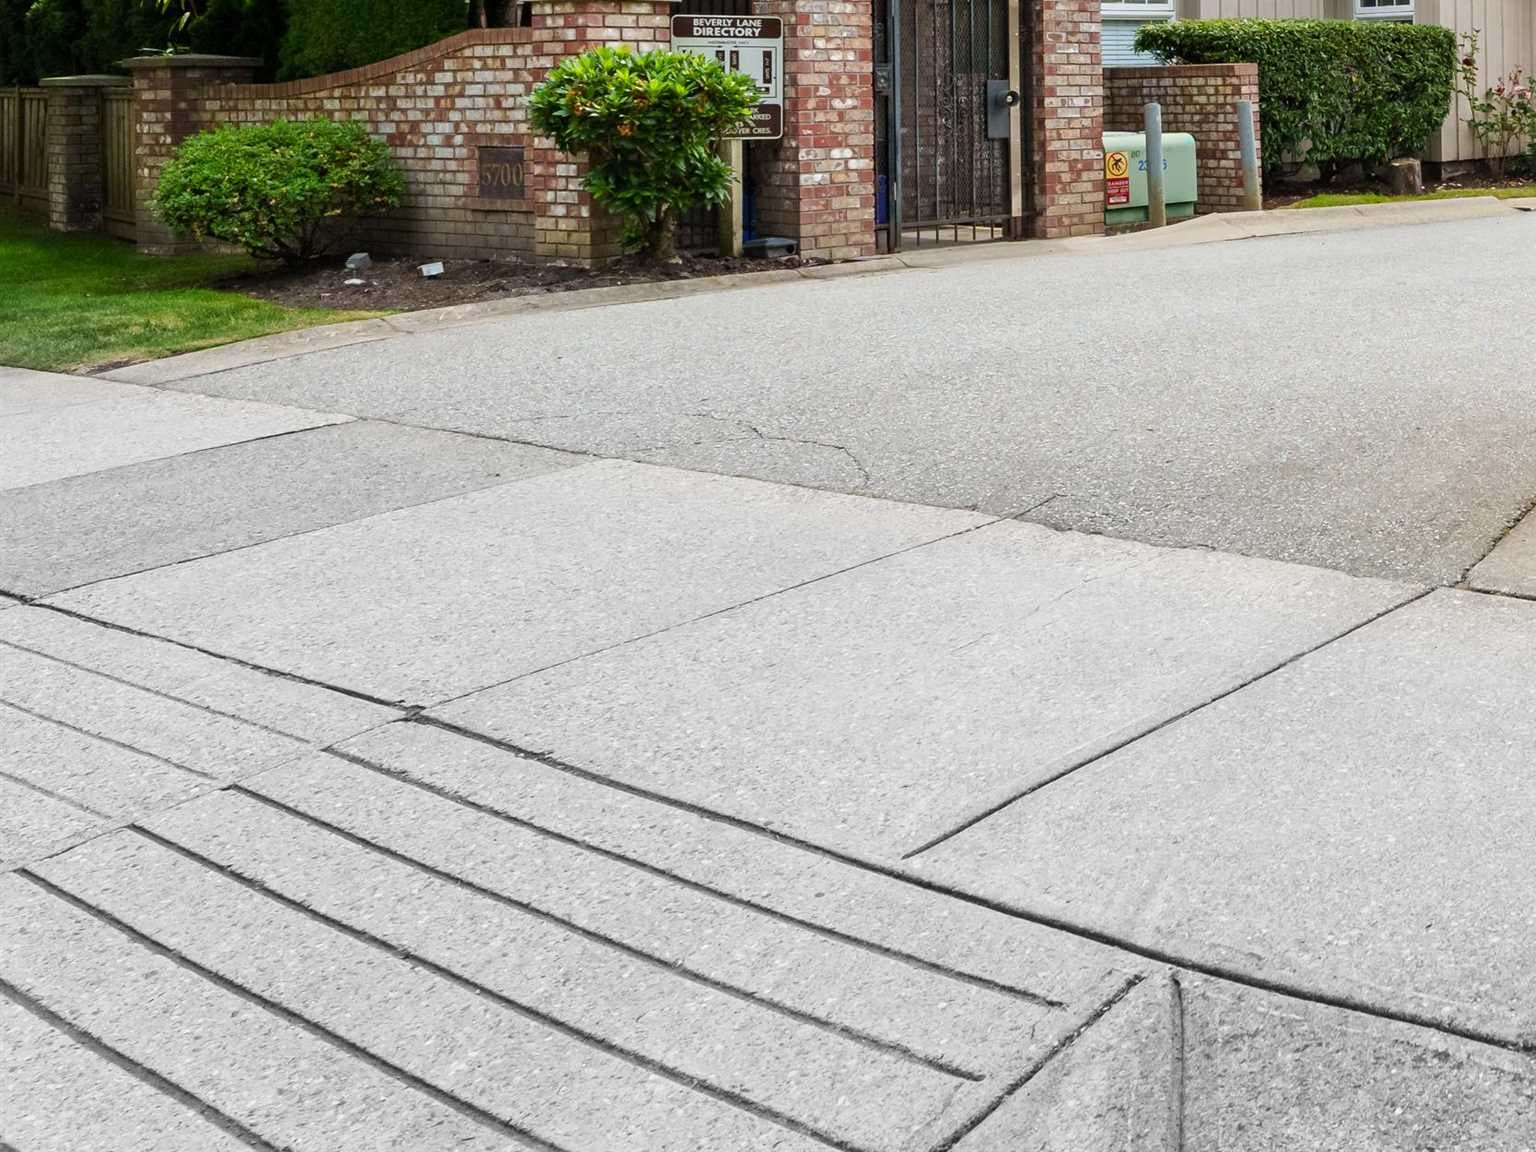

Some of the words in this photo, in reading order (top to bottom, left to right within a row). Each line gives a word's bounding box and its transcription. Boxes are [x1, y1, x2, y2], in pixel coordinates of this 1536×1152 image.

[693, 18, 733, 27] BEVERLY
[736, 19, 762, 27] LANE
[693, 27, 762, 37] DIRECTORY
[481, 163, 523, 186] 5700
